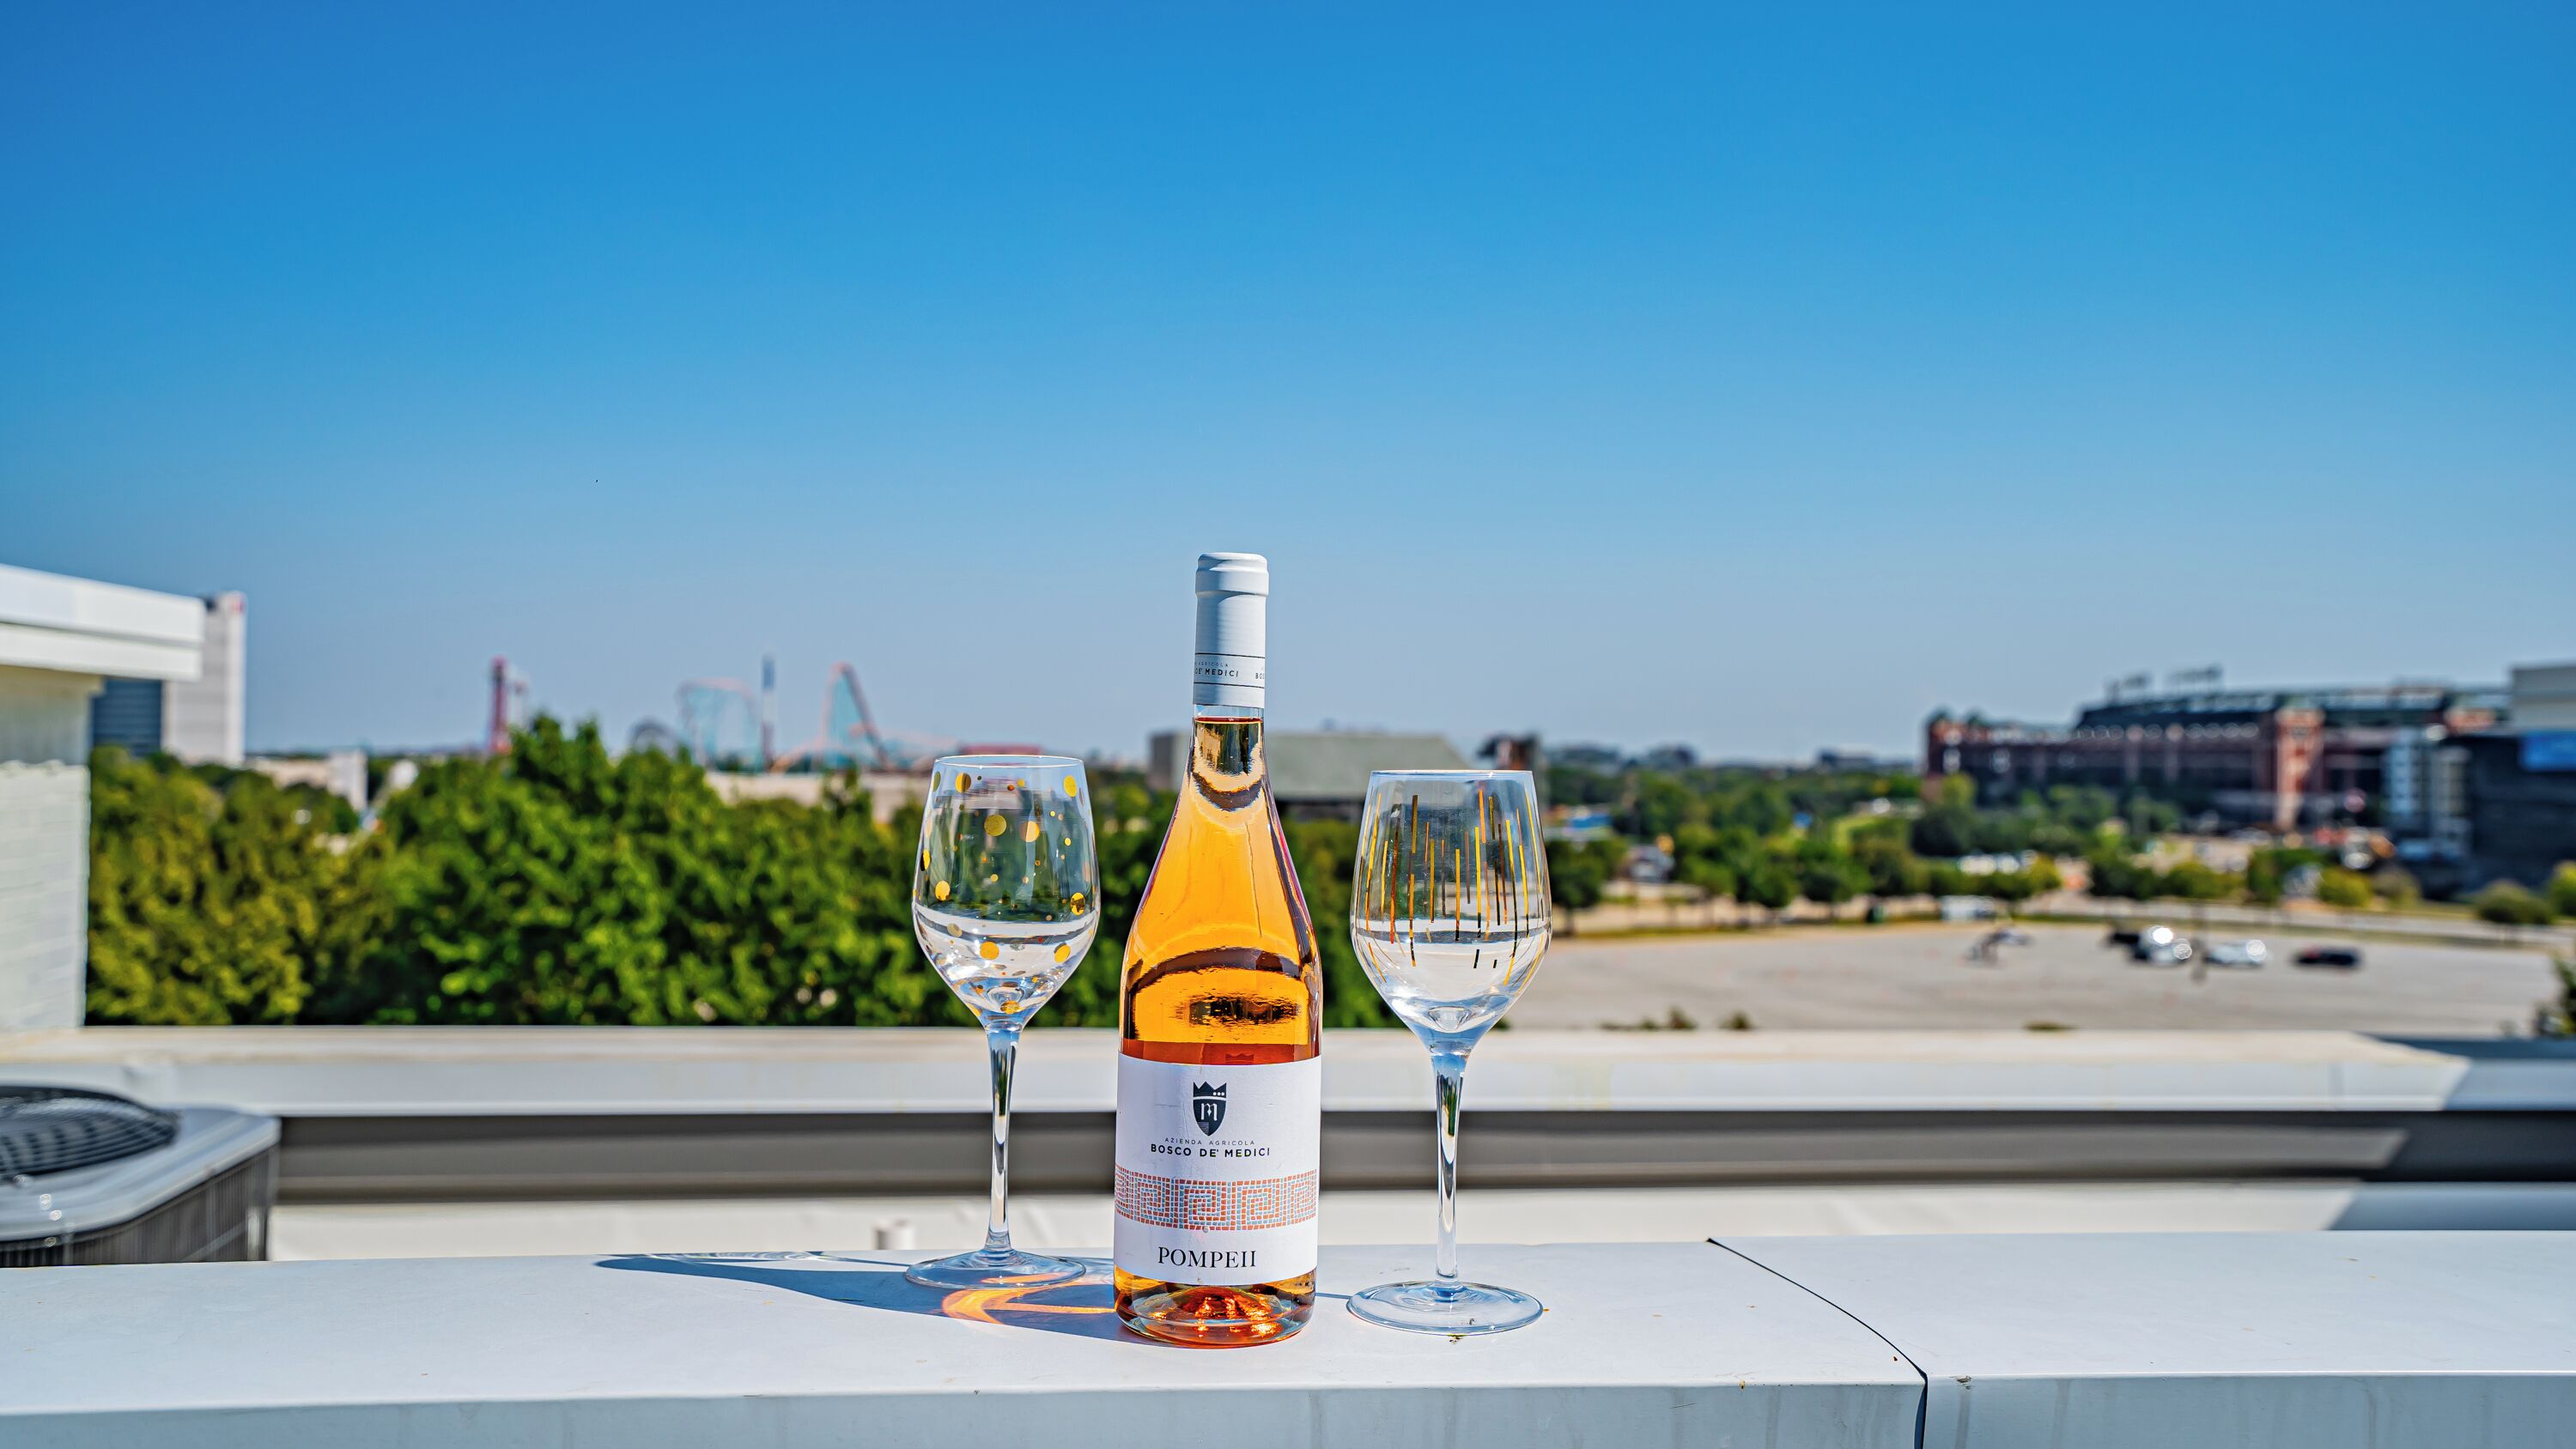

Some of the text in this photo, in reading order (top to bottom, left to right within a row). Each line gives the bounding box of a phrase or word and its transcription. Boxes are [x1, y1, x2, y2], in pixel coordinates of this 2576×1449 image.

[1205, 668, 1239, 677] MEDICI
[1151, 1143, 1270, 1157] BOSCO DE' MEDICI
[1157, 1246, 1256, 1268] POMPEII
